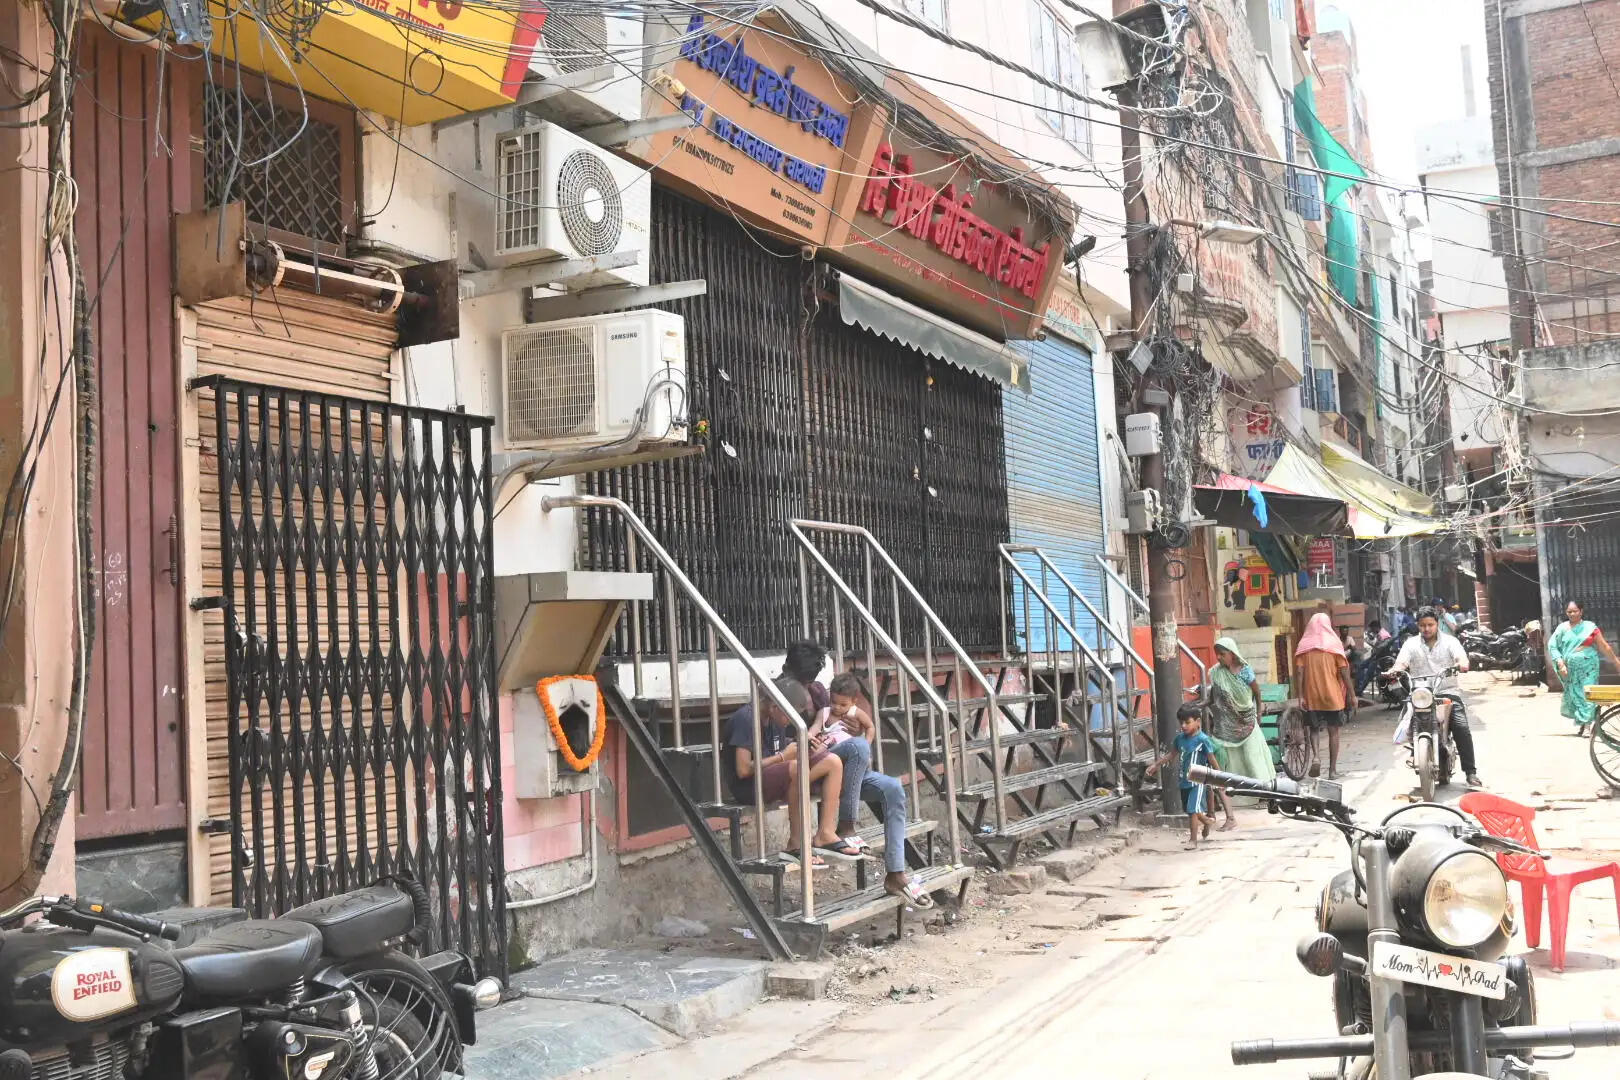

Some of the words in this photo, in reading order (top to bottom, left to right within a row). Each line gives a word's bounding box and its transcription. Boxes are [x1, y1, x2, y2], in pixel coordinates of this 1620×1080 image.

[784, 155, 827, 195] वाराणसी
[610, 332, 638, 341] SAMSUNG
[76, 969, 117, 986] ROYAL
[1382, 954, 1414, 974] Mom
[1474, 970, 1500, 990] Dad
[73, 980, 122, 1001] ENFIELD
